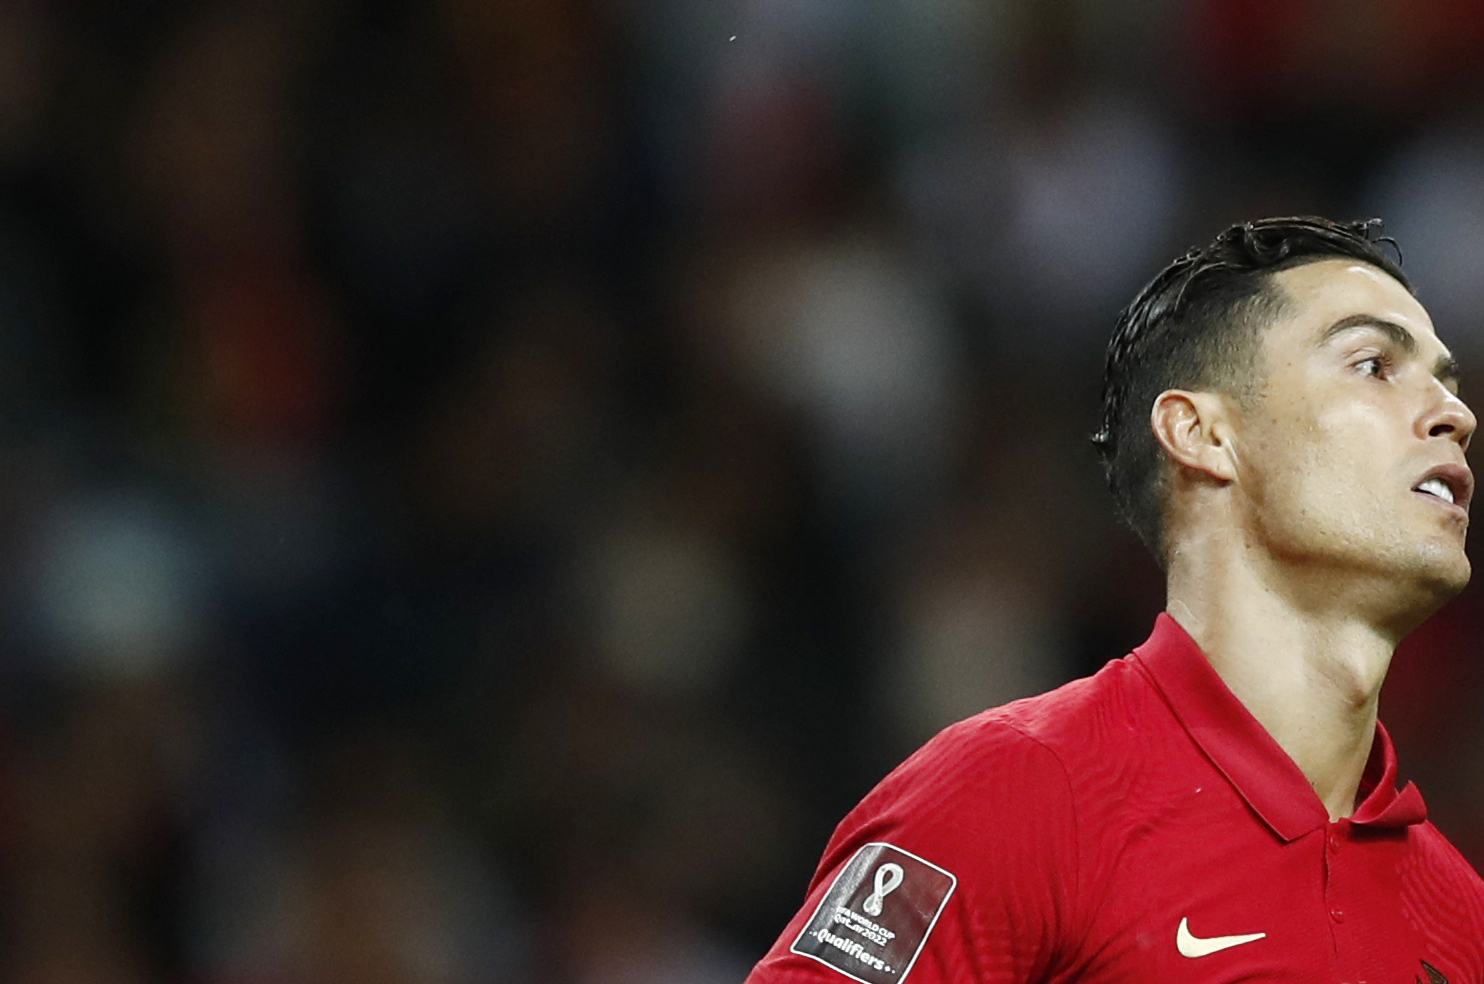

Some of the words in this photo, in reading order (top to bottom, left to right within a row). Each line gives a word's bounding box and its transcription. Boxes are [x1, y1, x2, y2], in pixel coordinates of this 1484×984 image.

[851, 911, 879, 931] WORLD
[878, 927, 896, 939] CUP
[817, 928, 885, 970] Qualifiers
